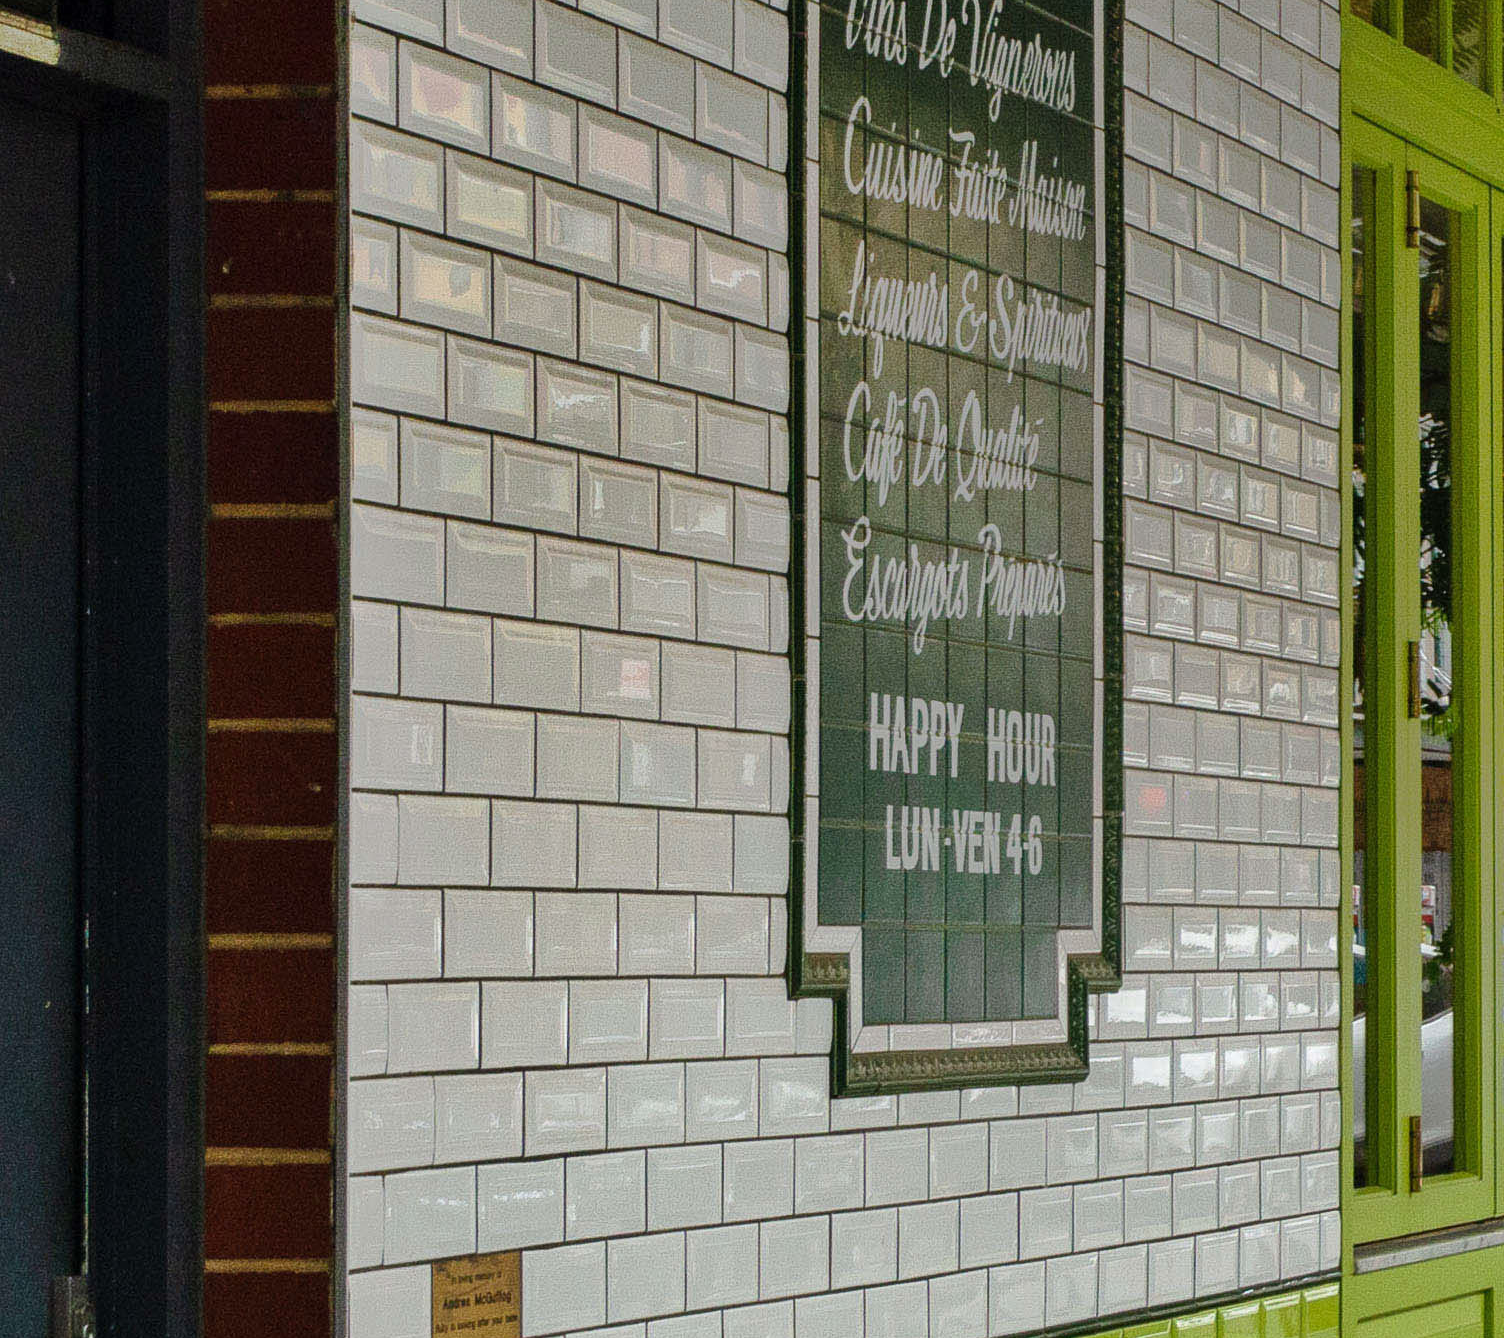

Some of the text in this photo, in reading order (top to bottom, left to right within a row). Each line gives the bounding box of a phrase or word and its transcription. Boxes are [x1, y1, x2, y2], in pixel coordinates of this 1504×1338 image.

[844, 96, 1086, 241] Cuisine Faite Maison
[838, 240, 1091, 384] Liqueurs & Spiritueux
[843, 380, 1045, 507] Café De Qualité
[841, 516, 969, 655] Escargots
[869, 691, 1056, 788] HAPPY HOUR
[885, 804, 1044, 876] LUN-VEN 4-6
